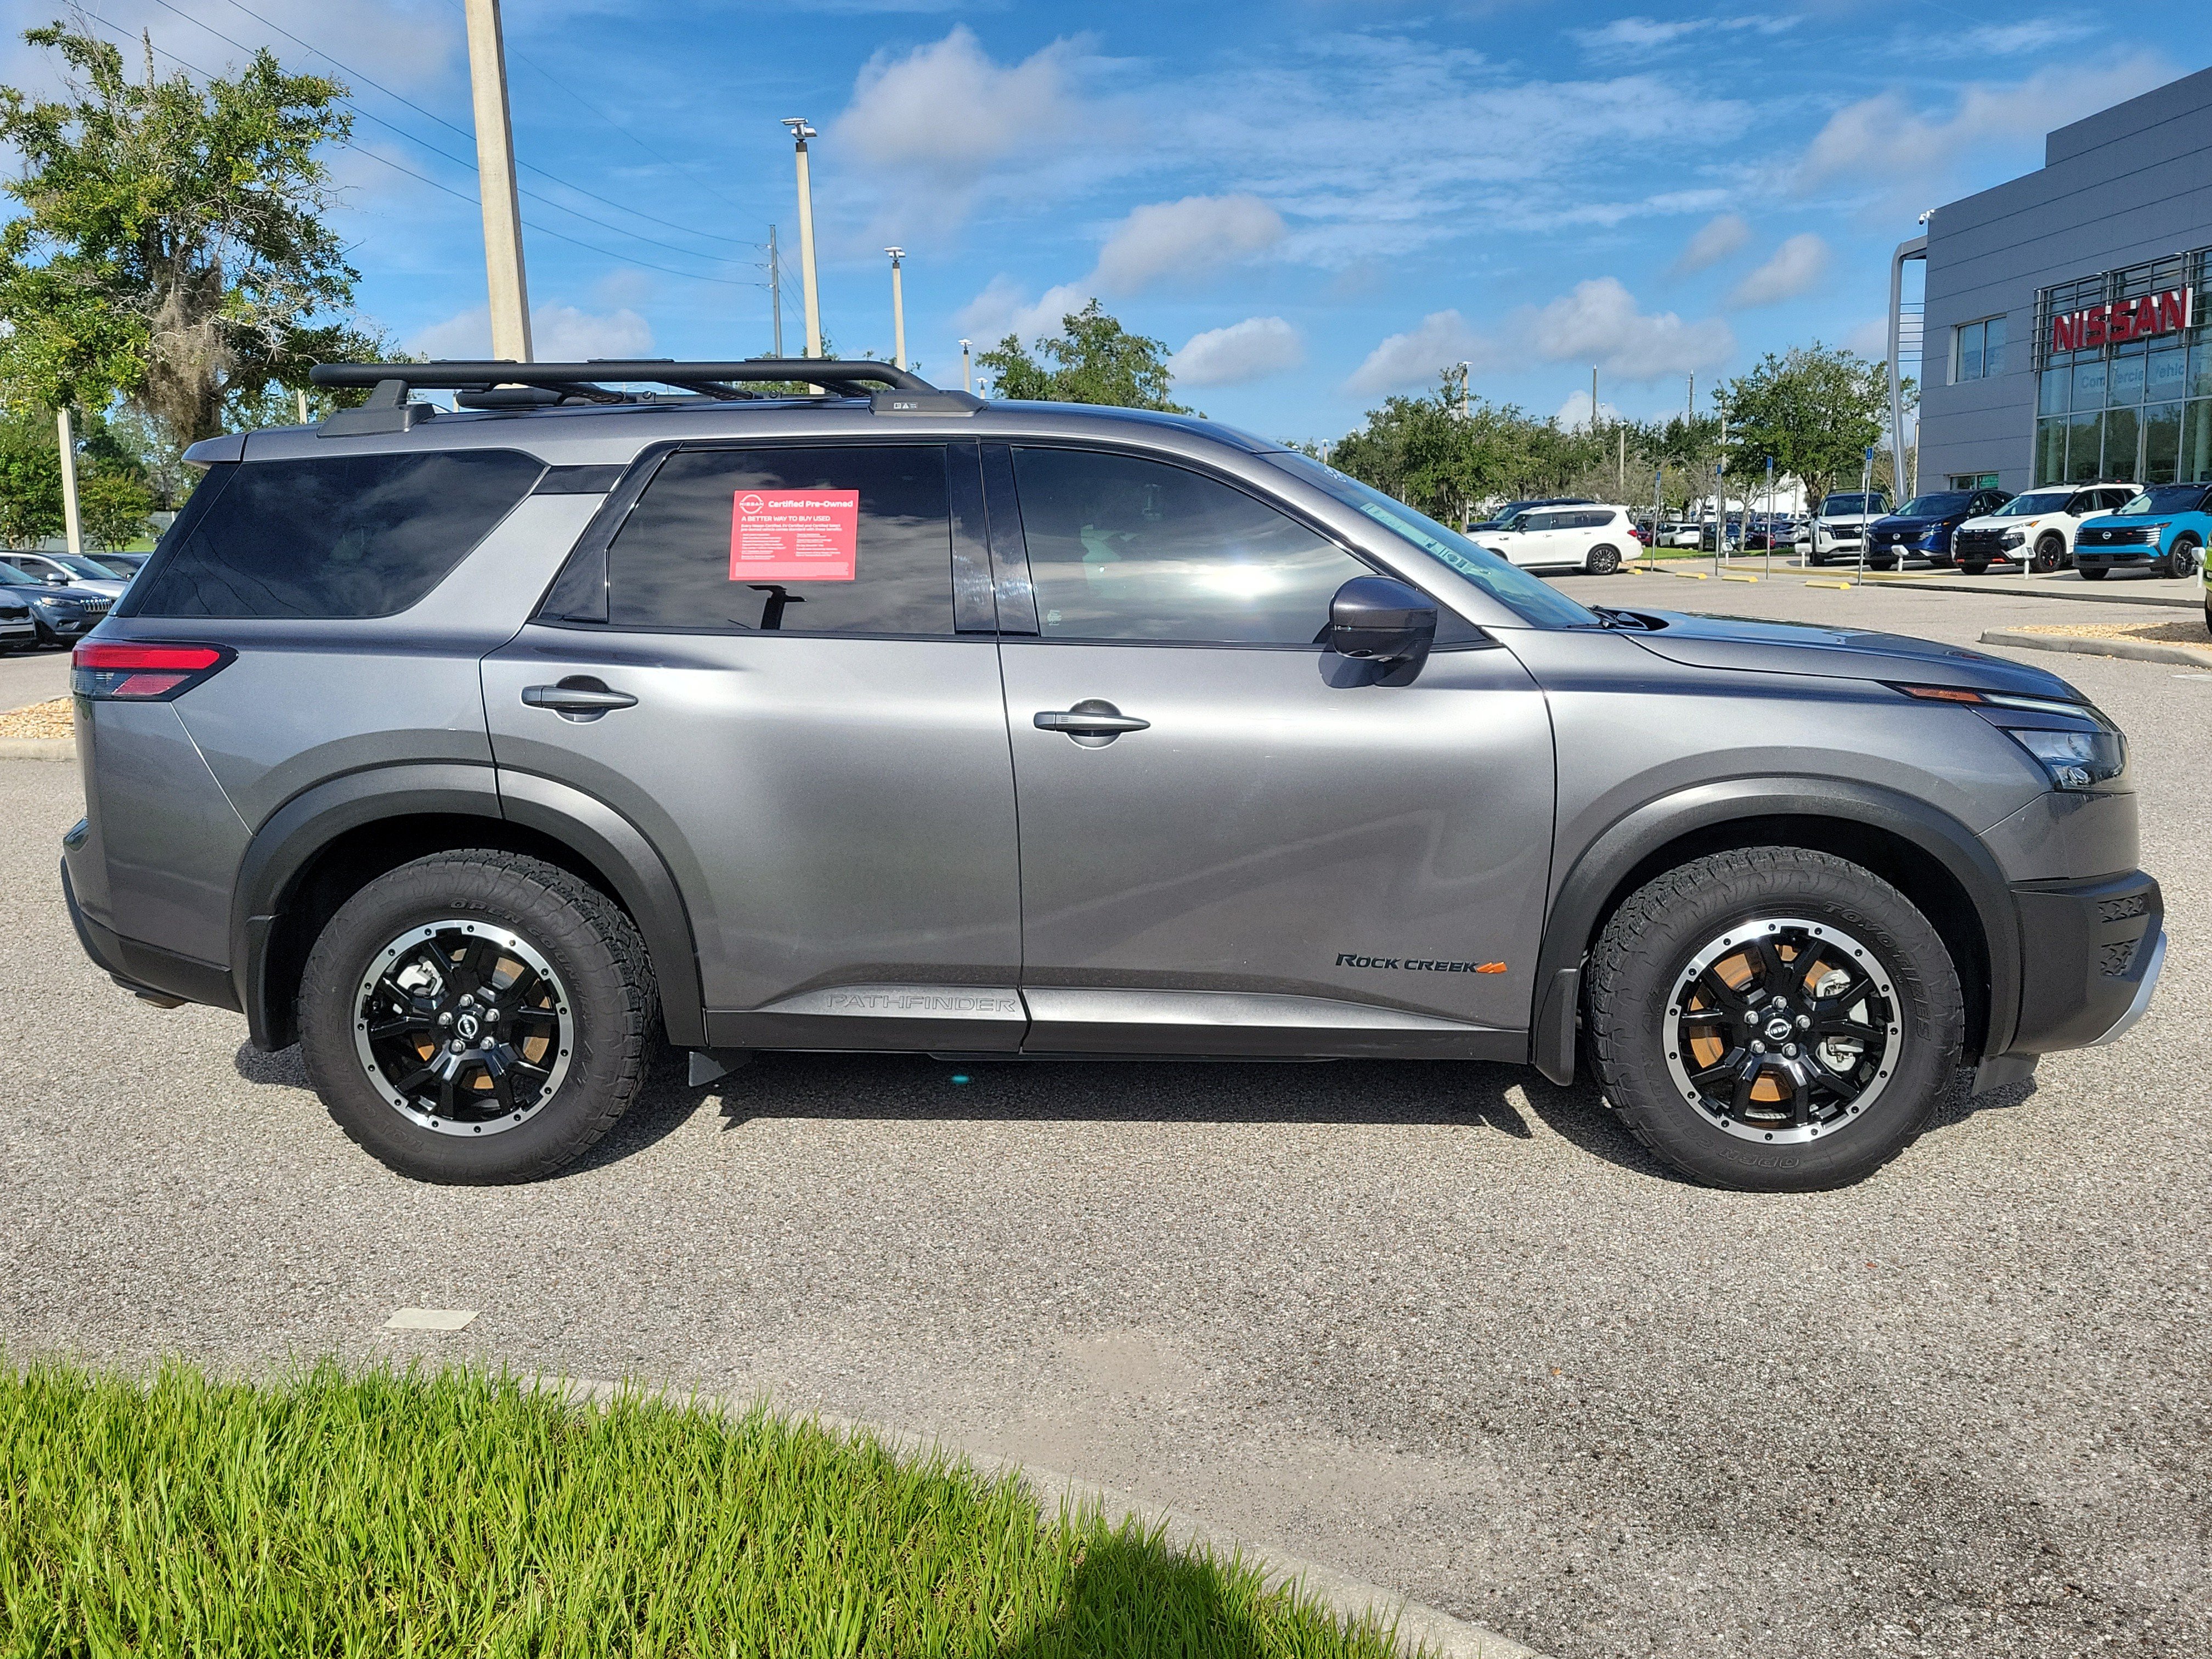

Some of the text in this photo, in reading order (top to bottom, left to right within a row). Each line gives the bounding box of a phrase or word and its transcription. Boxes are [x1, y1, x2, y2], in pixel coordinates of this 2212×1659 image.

[2053, 289, 2192, 352] NISSAN
[450, 898, 523, 924] OPEN
[1335, 952, 1479, 973] ROCK CREEK
[1824, 901, 1931, 1041] TOYO TIRES
[827, 994, 1015, 1012] PATHFINDER
[1764, 1024, 1792, 1036] NISSAN
